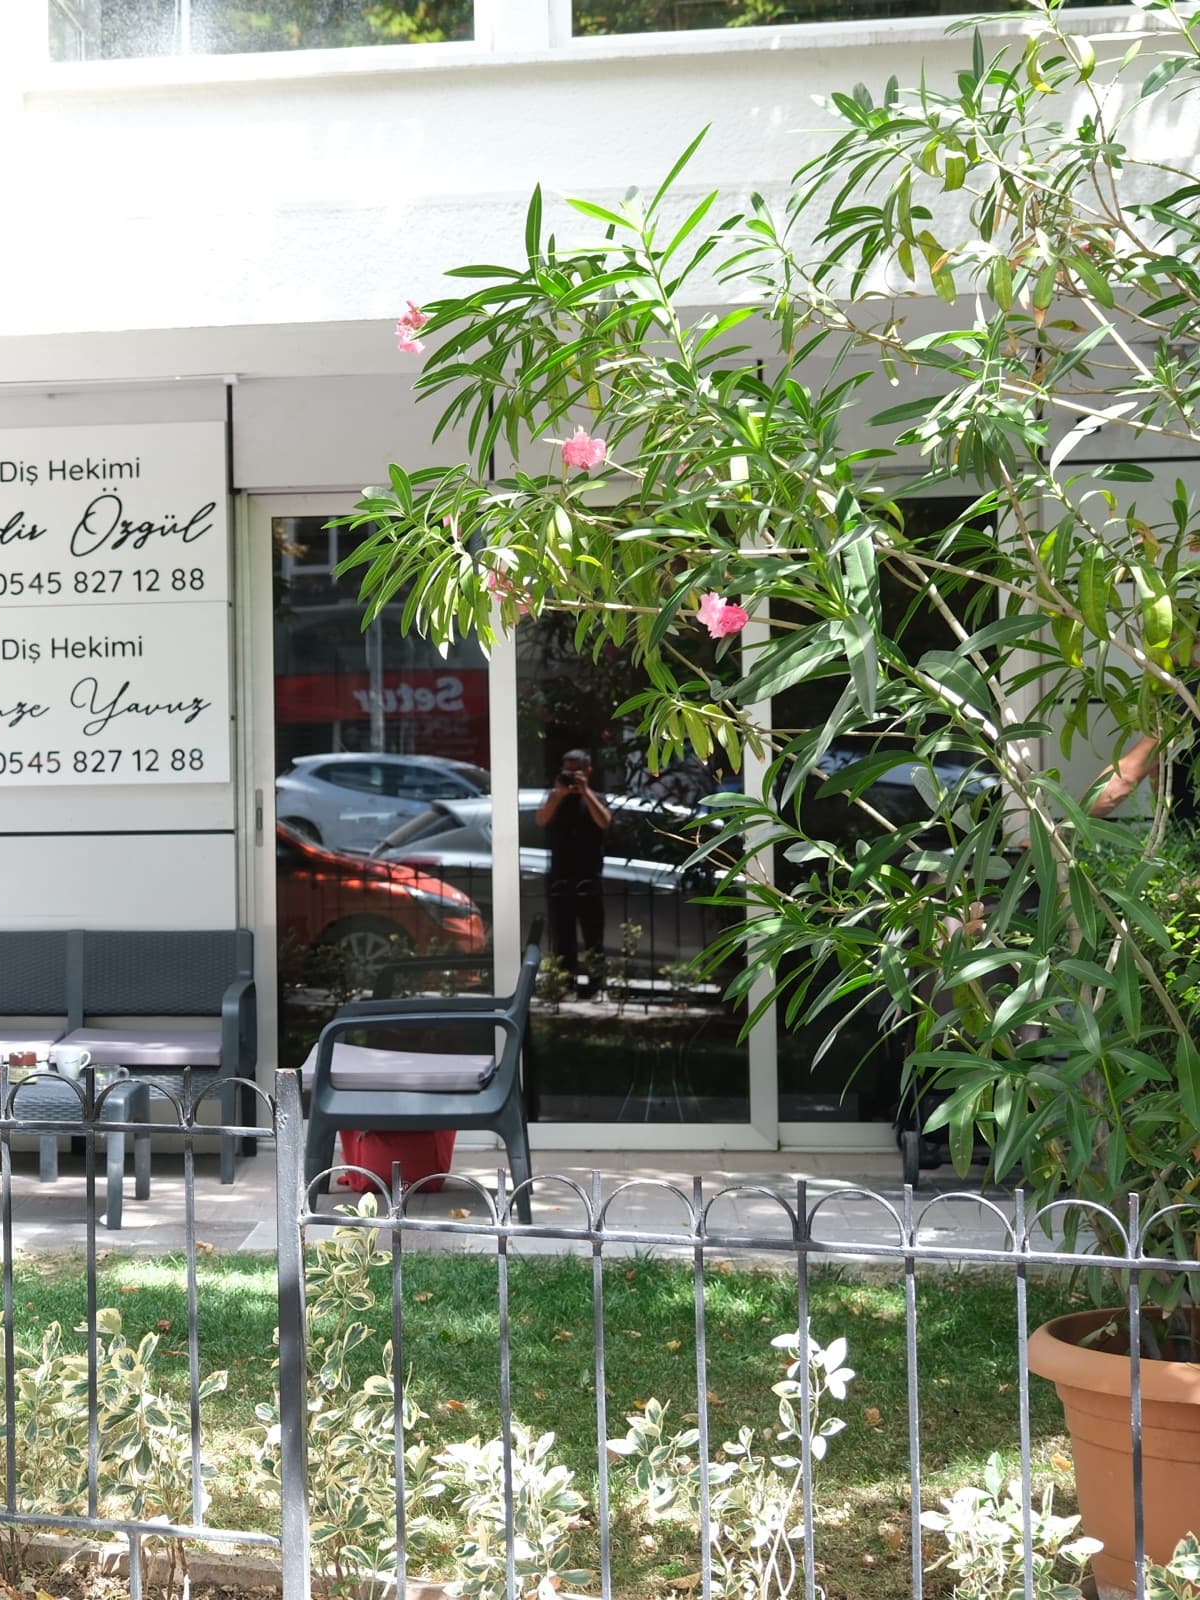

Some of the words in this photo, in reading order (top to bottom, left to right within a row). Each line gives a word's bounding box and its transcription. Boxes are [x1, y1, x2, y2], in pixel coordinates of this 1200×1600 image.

[0, 460, 39, 487] Diş
[48, 456, 141, 482] Hekimi
[69, 487, 217, 558] Özgül
[73, 569, 124, 594] 827
[132, 568, 161, 593] 12
[171, 567, 205, 592] 88
[1, 637, 41, 664] Diş
[51, 635, 143, 660] Hekimi
[69, 676, 212, 737] Yavuz
[72, 749, 123, 774] 827
[131, 748, 160, 773] 12
[170, 747, 204, 772] 88
